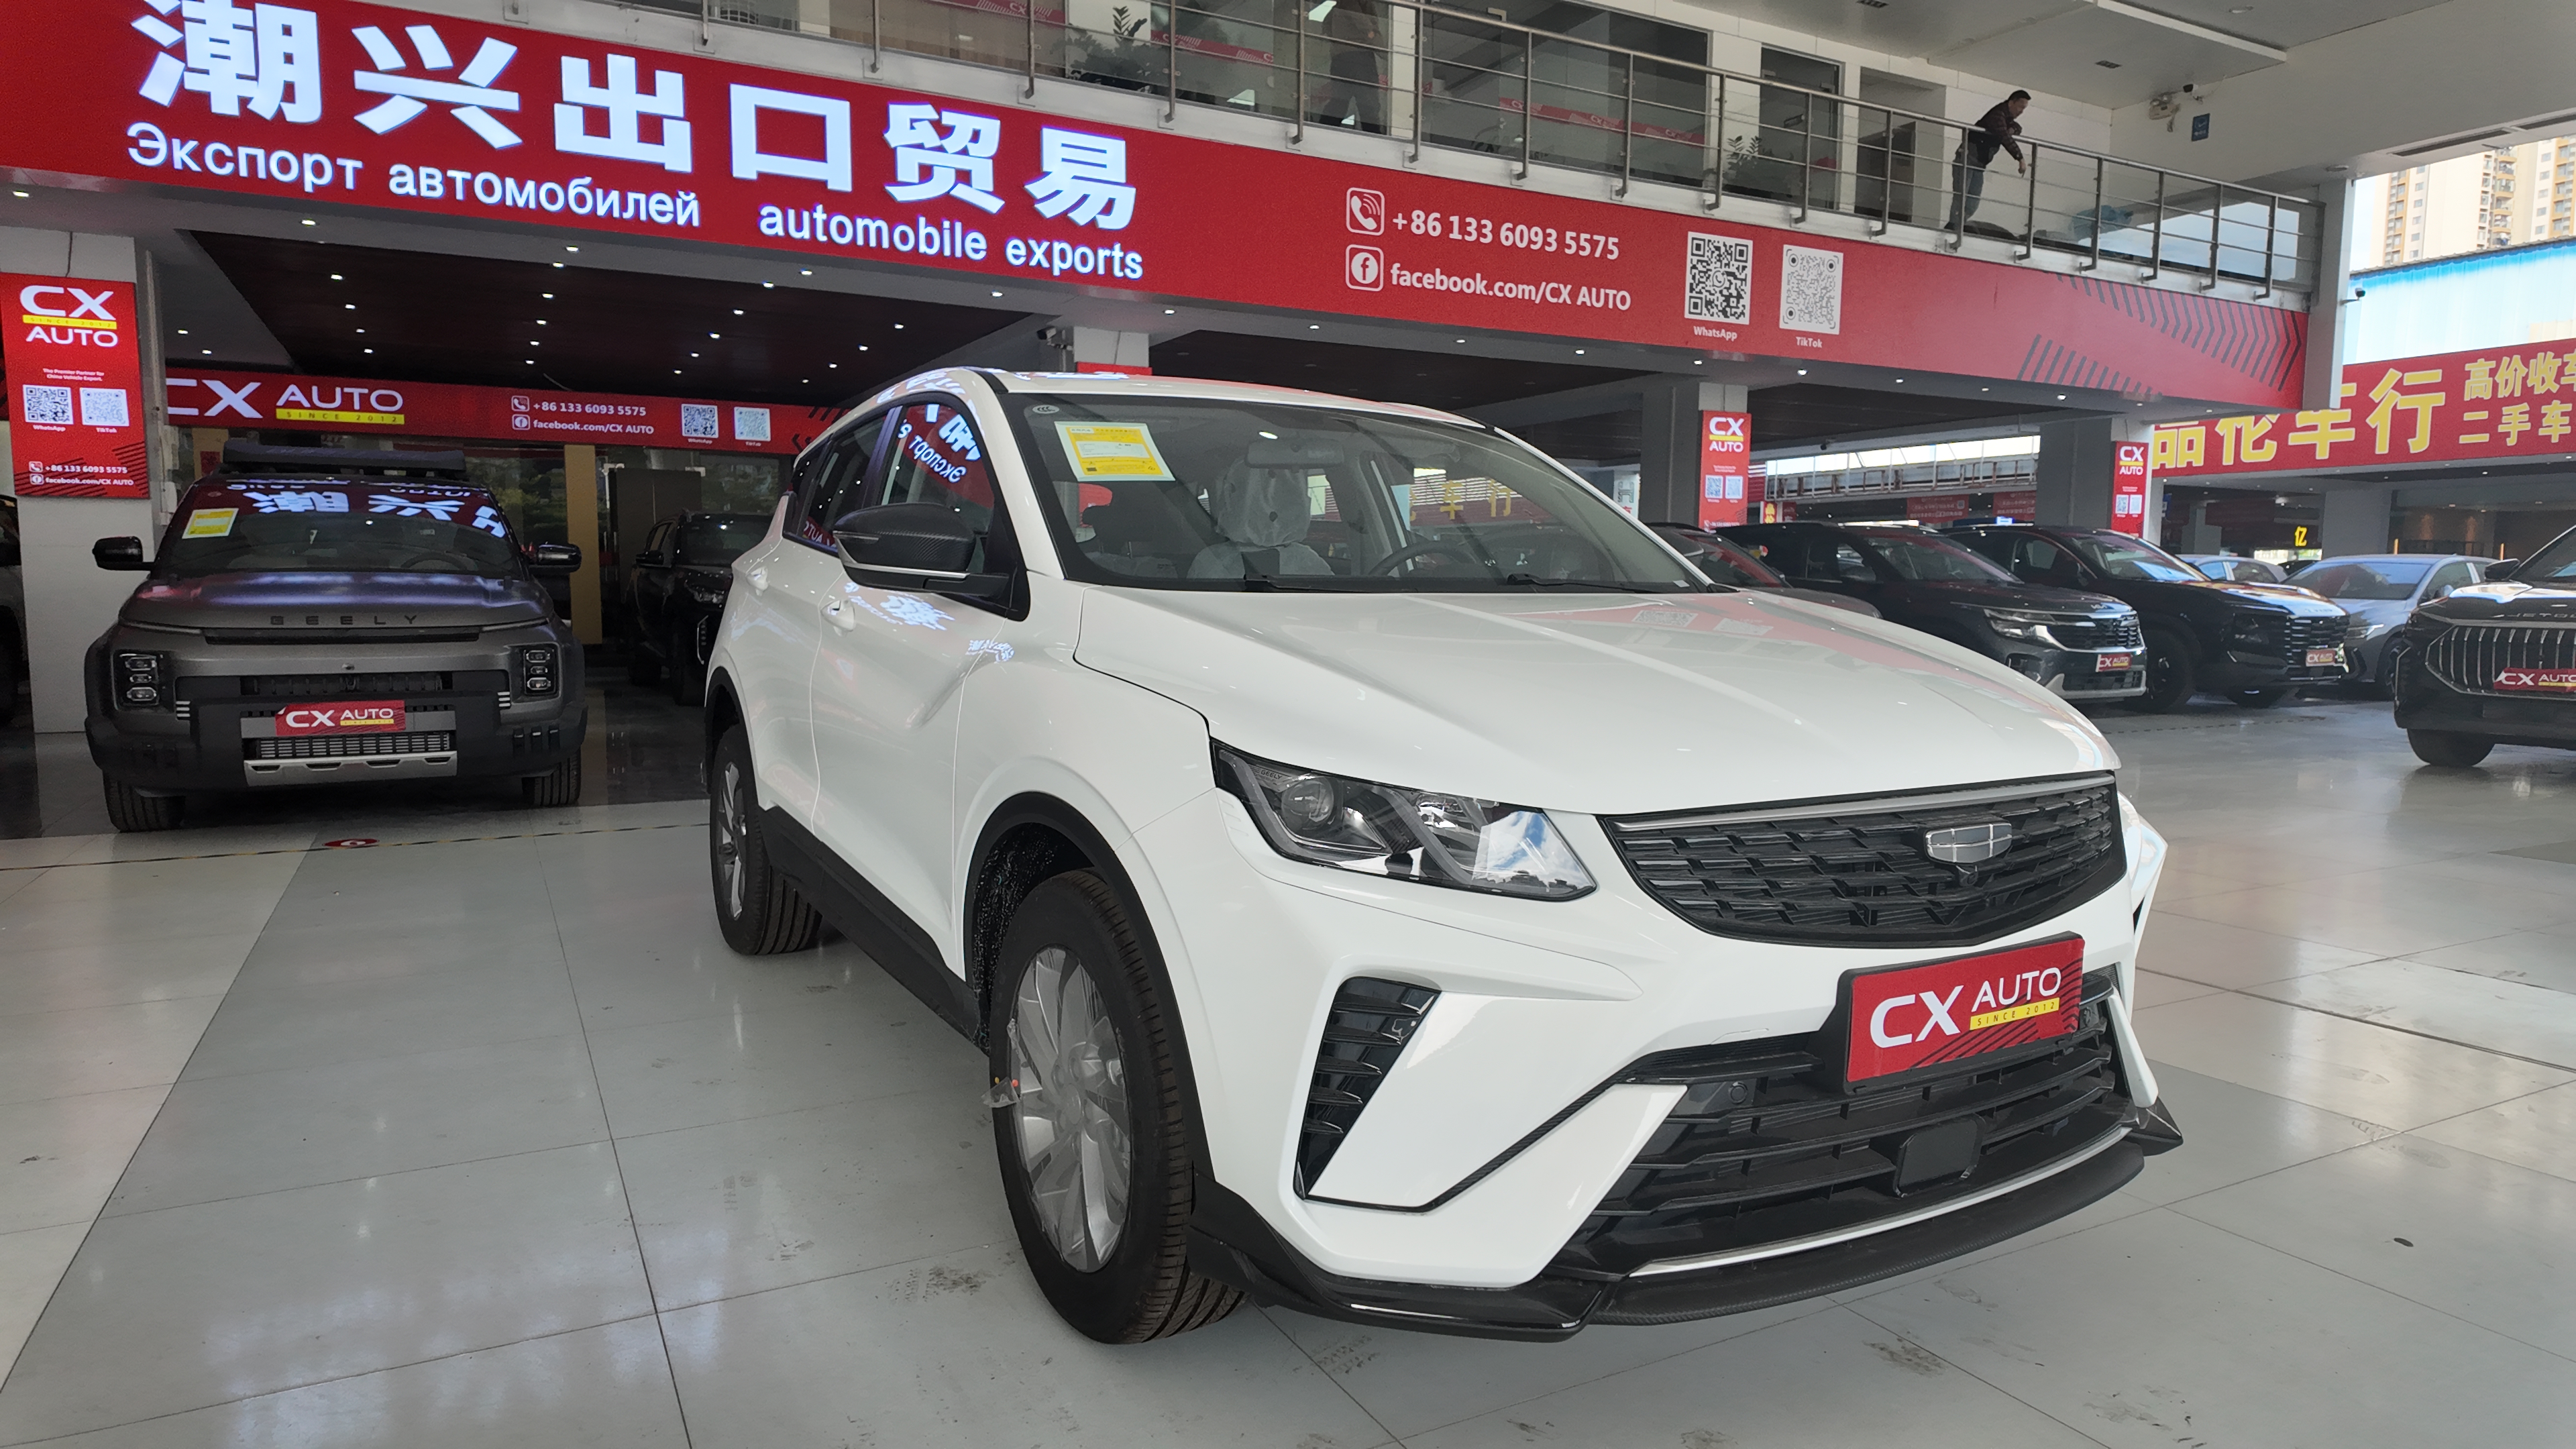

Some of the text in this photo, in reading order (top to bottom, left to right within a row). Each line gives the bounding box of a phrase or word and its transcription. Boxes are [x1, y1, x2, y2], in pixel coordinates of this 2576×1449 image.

[131, 0, 1136, 230] 潮兴出口贸易
[127, 121, 700, 228] Экспорт автомобилей
[759, 203, 1144, 280] automobile exports
[1393, 209, 1619, 260] +86 133 6093 5575
[1390, 262, 1631, 311] facebook.com/CX AUTO
[20, 284, 116, 321] CX
[25, 326, 119, 347] AUTO
[1693, 325, 1737, 342] WhatsApp
[1795, 336, 1823, 349] TikTok
[276, 384, 402, 412] AUTO
[287, 411, 396, 423] SINCE 2012
[533, 401, 647, 417] +86 133 6093 5575
[533, 419, 655, 435] facebook.com/CX AUTO
[1709, 417, 1745, 436] CX
[2459, 399, 2573, 446] 二手车
[1709, 441, 1743, 453] AUTO
[2119, 445, 2145, 462] CX
[2119, 466, 2143, 476] AUTO
[270, 614, 417, 625] GEELY
[2501, 672, 2536, 686] CX
[286, 708, 394, 728] CX AUTO
[1870, 967, 2061, 1049] CX AUTO
[1977, 1001, 2057, 1027] SINCE 2012
